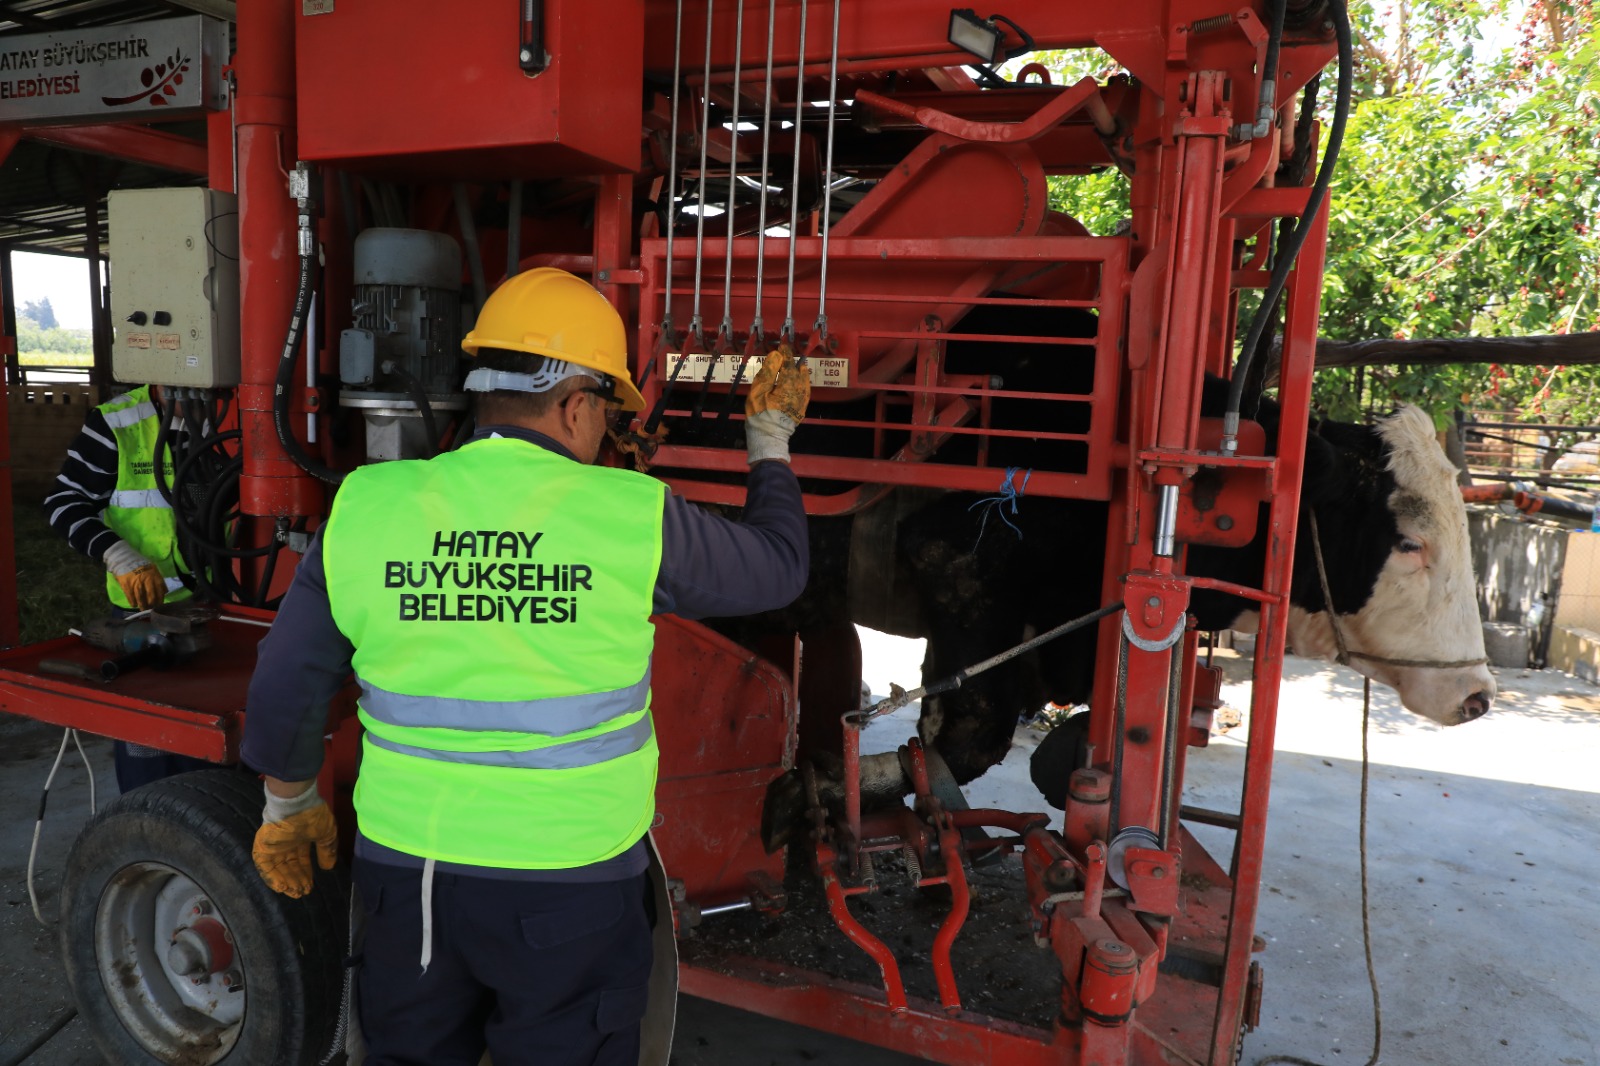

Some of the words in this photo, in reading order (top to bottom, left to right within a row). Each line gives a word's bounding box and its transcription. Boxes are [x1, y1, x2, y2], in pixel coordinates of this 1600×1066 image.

[43, 34, 149, 67] BÜYÜKŞEHİR
[819, 360, 846, 368] FRONT
[432, 530, 544, 558] HATAY
[384, 561, 593, 592] BÜYÜKŞEHİR
[399, 593, 577, 623] BELEDİYESİ
